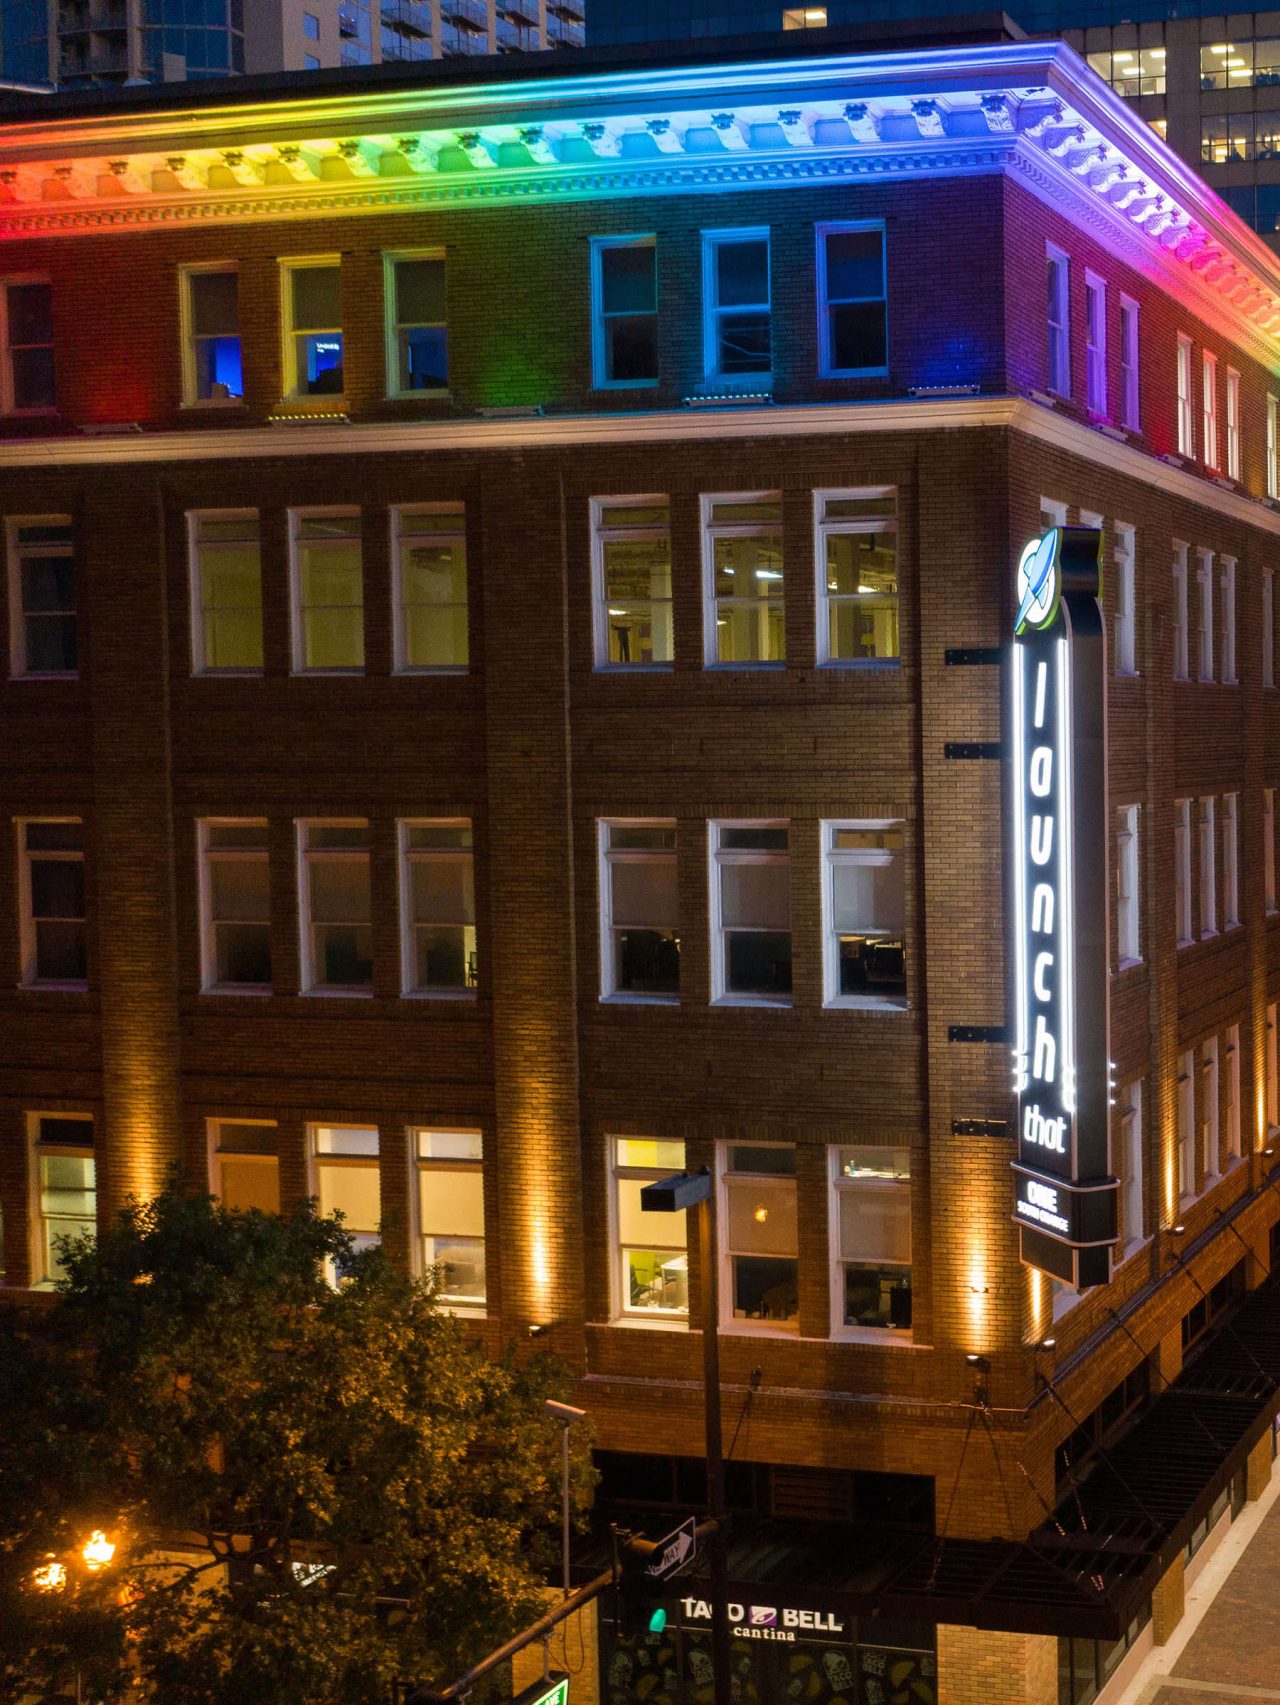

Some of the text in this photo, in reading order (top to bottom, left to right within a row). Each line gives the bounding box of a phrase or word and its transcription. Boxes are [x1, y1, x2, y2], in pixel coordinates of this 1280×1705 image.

[1030, 661, 1056, 1083] launch
[680, 1596, 843, 1632] TAO BELL
[733, 1626, 796, 1642] cantina
